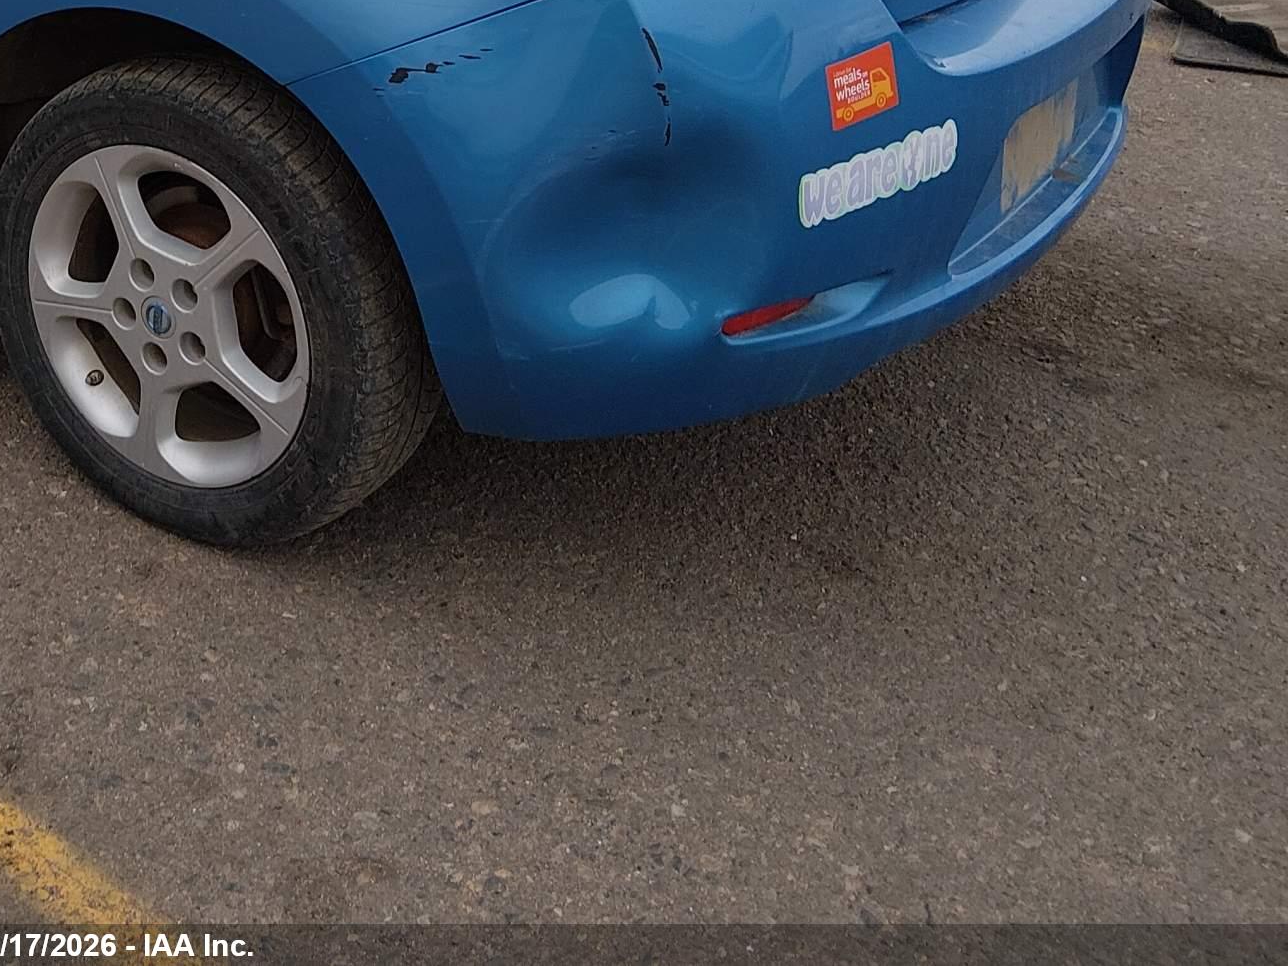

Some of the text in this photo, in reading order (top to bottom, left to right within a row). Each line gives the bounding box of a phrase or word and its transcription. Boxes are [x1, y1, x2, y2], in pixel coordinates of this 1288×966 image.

[834, 67, 862, 89] meals
[835, 78, 870, 102] wheels
[846, 147, 898, 208] are
